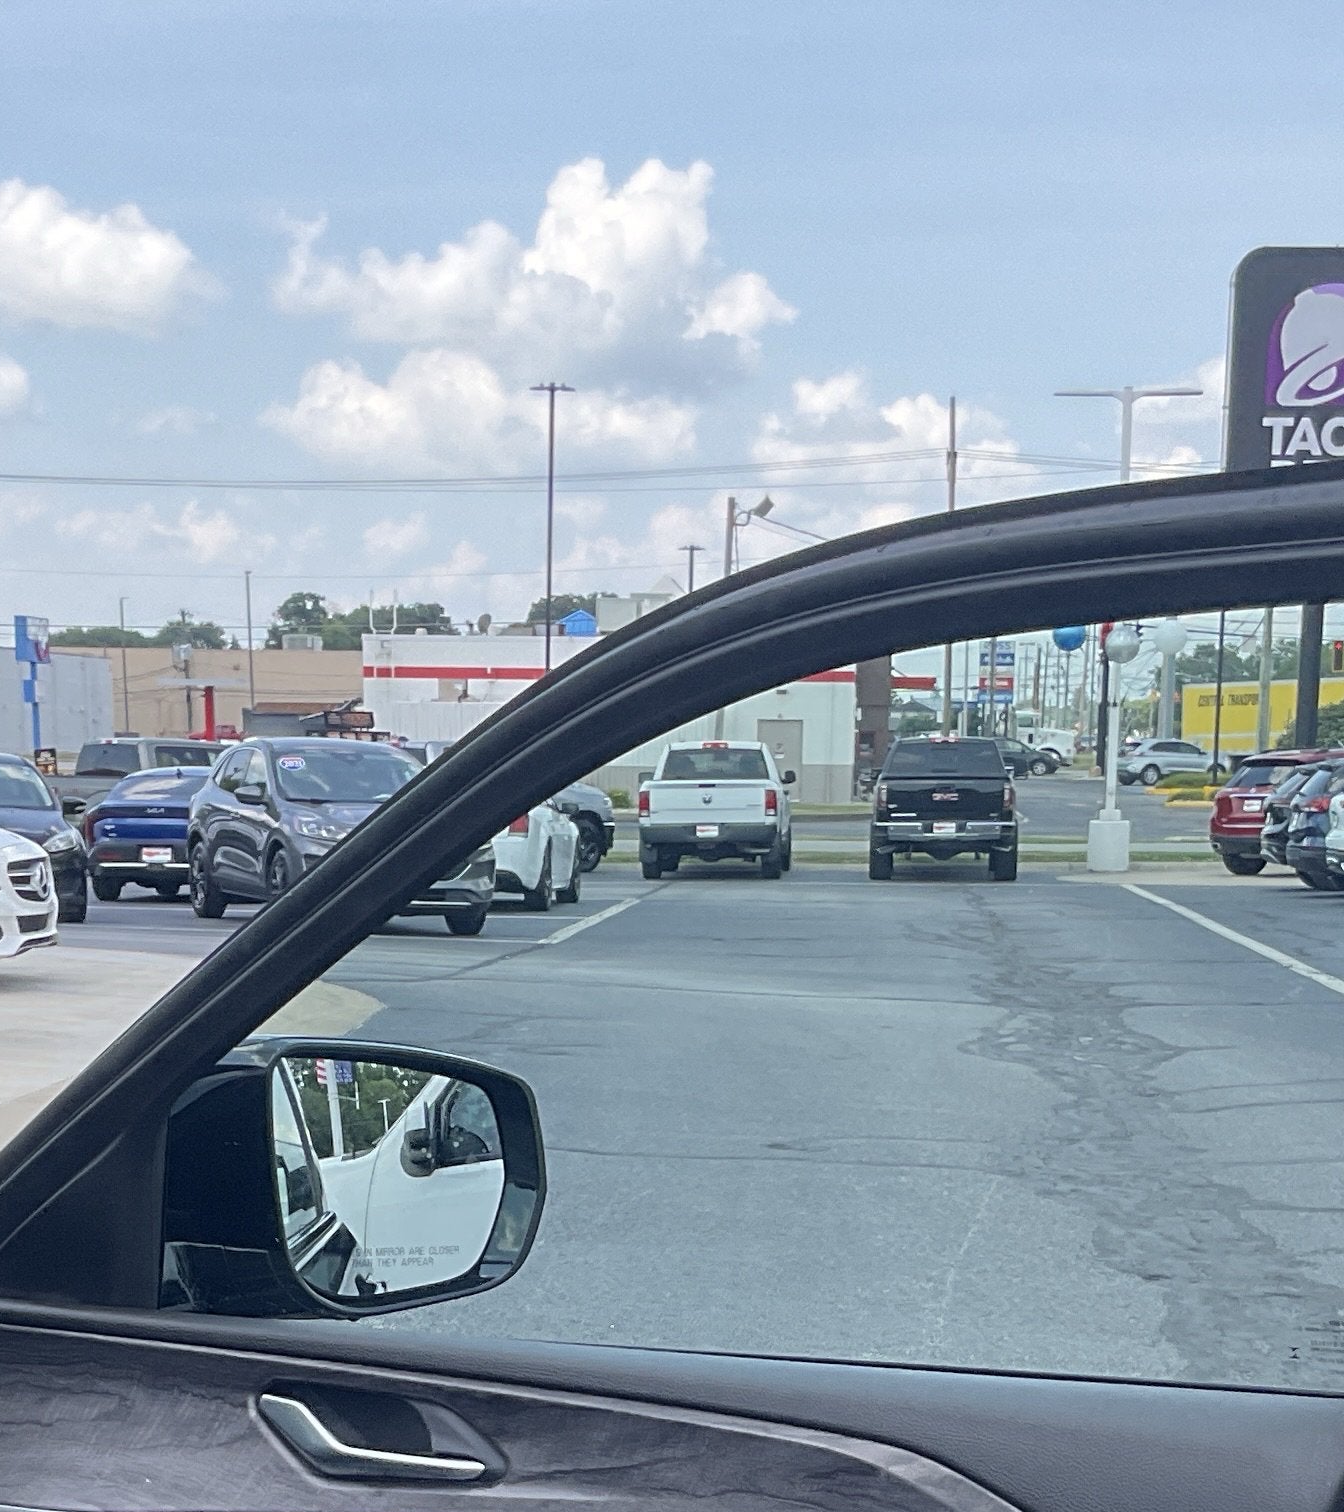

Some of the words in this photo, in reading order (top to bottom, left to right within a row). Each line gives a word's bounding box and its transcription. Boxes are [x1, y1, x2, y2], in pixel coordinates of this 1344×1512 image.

[375, 1246, 406, 1257] MIRROR
[408, 1245, 426, 1256] ARE
[428, 1244, 460, 1256] CLOSER
[377, 1257, 397, 1268] THEY
[400, 1255, 435, 1267] APPEAR
